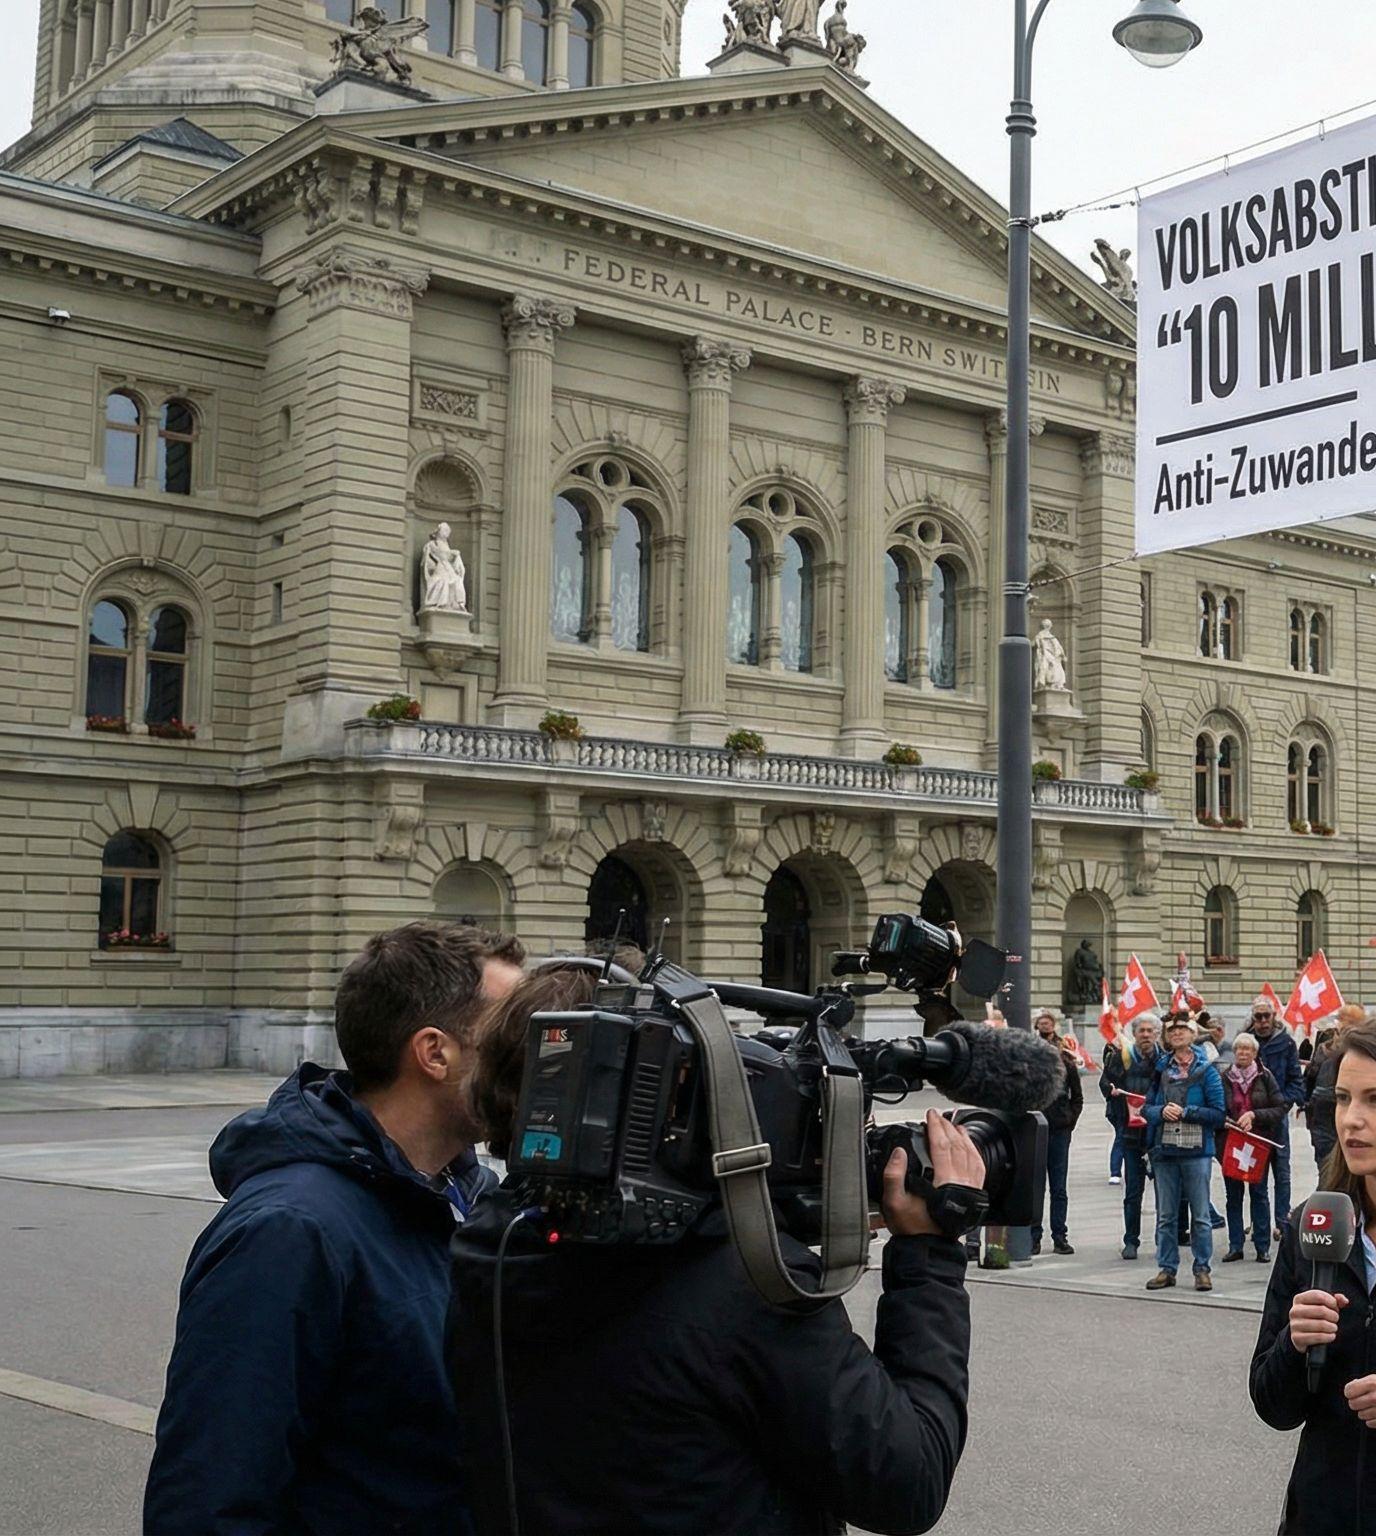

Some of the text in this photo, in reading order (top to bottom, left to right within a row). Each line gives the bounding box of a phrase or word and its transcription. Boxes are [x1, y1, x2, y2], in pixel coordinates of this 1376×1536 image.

[563, 248, 710, 306] FEDERAL
[726, 290, 833, 336] PALACE
[862, 326, 932, 361] BERN
[1302, 1232, 1333, 1246] NEWS
